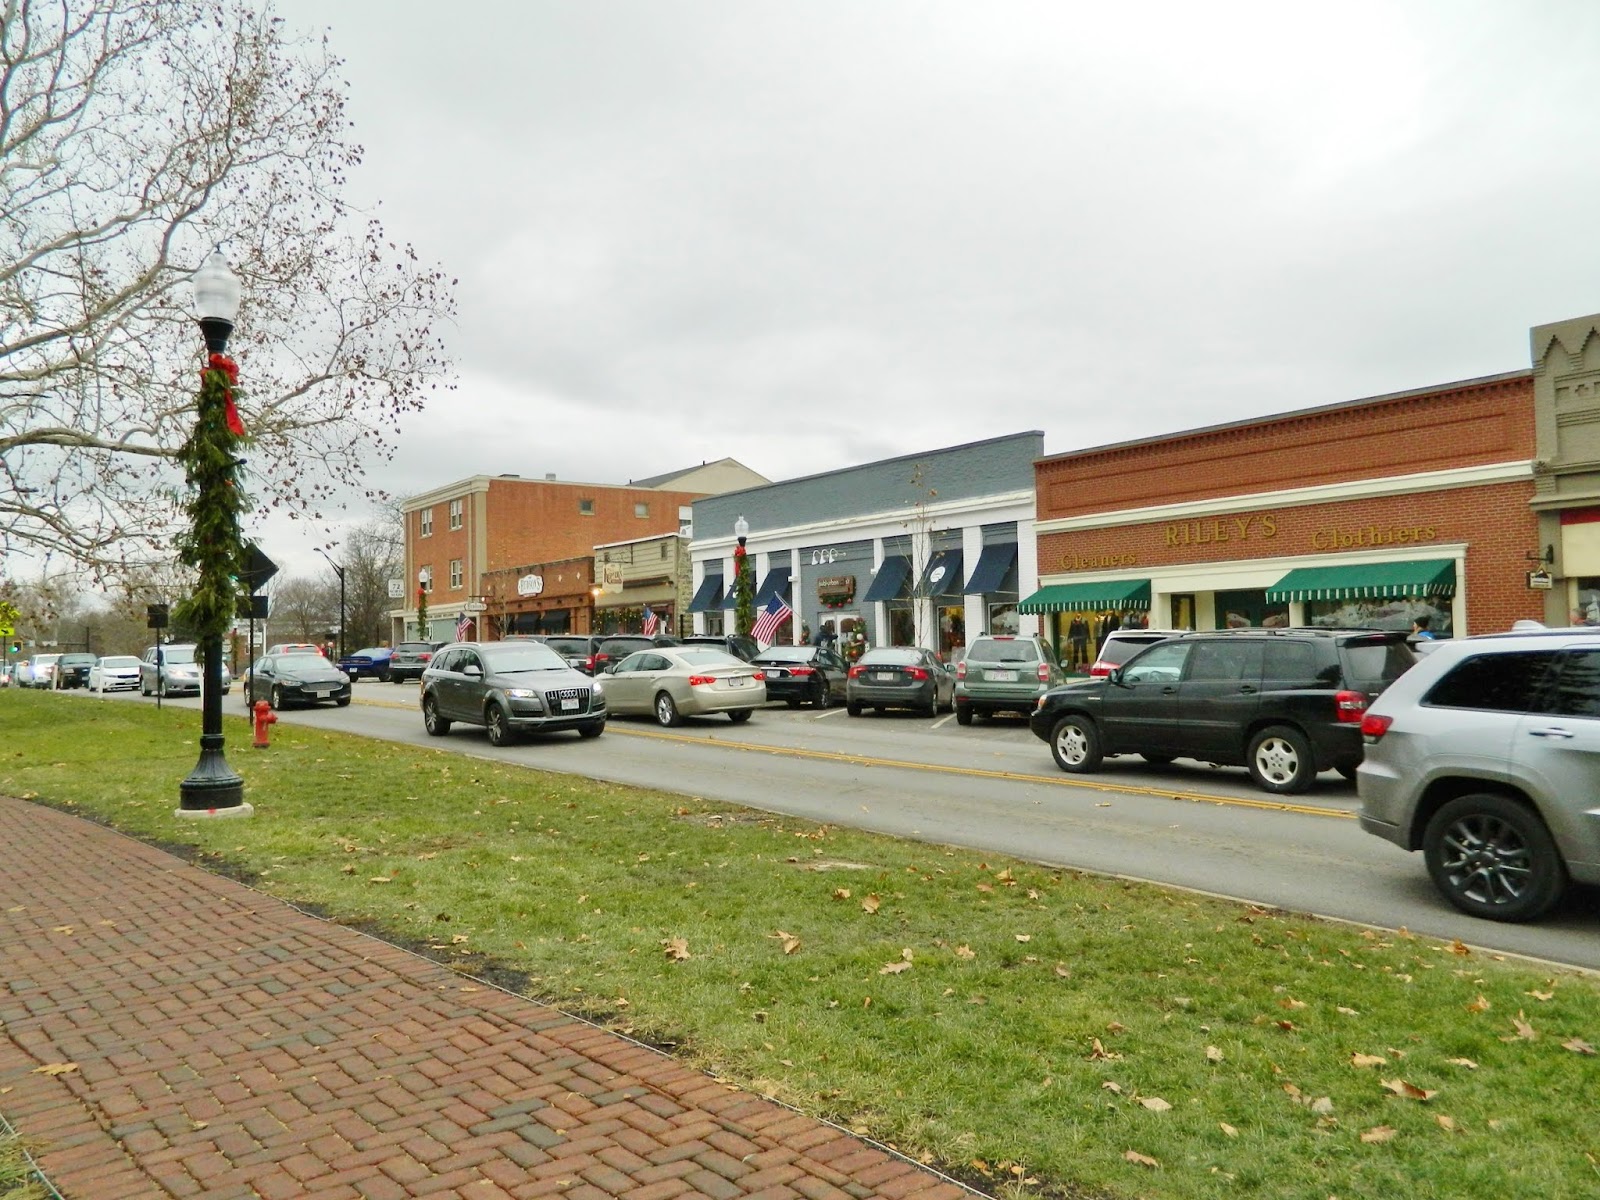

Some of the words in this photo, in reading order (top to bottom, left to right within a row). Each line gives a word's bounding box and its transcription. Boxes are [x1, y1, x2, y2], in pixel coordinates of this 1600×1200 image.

[1165, 513, 1277, 546] RILEY'S
[1312, 525, 1437, 550] Clothiers
[1059, 552, 1138, 570] Cleaners
